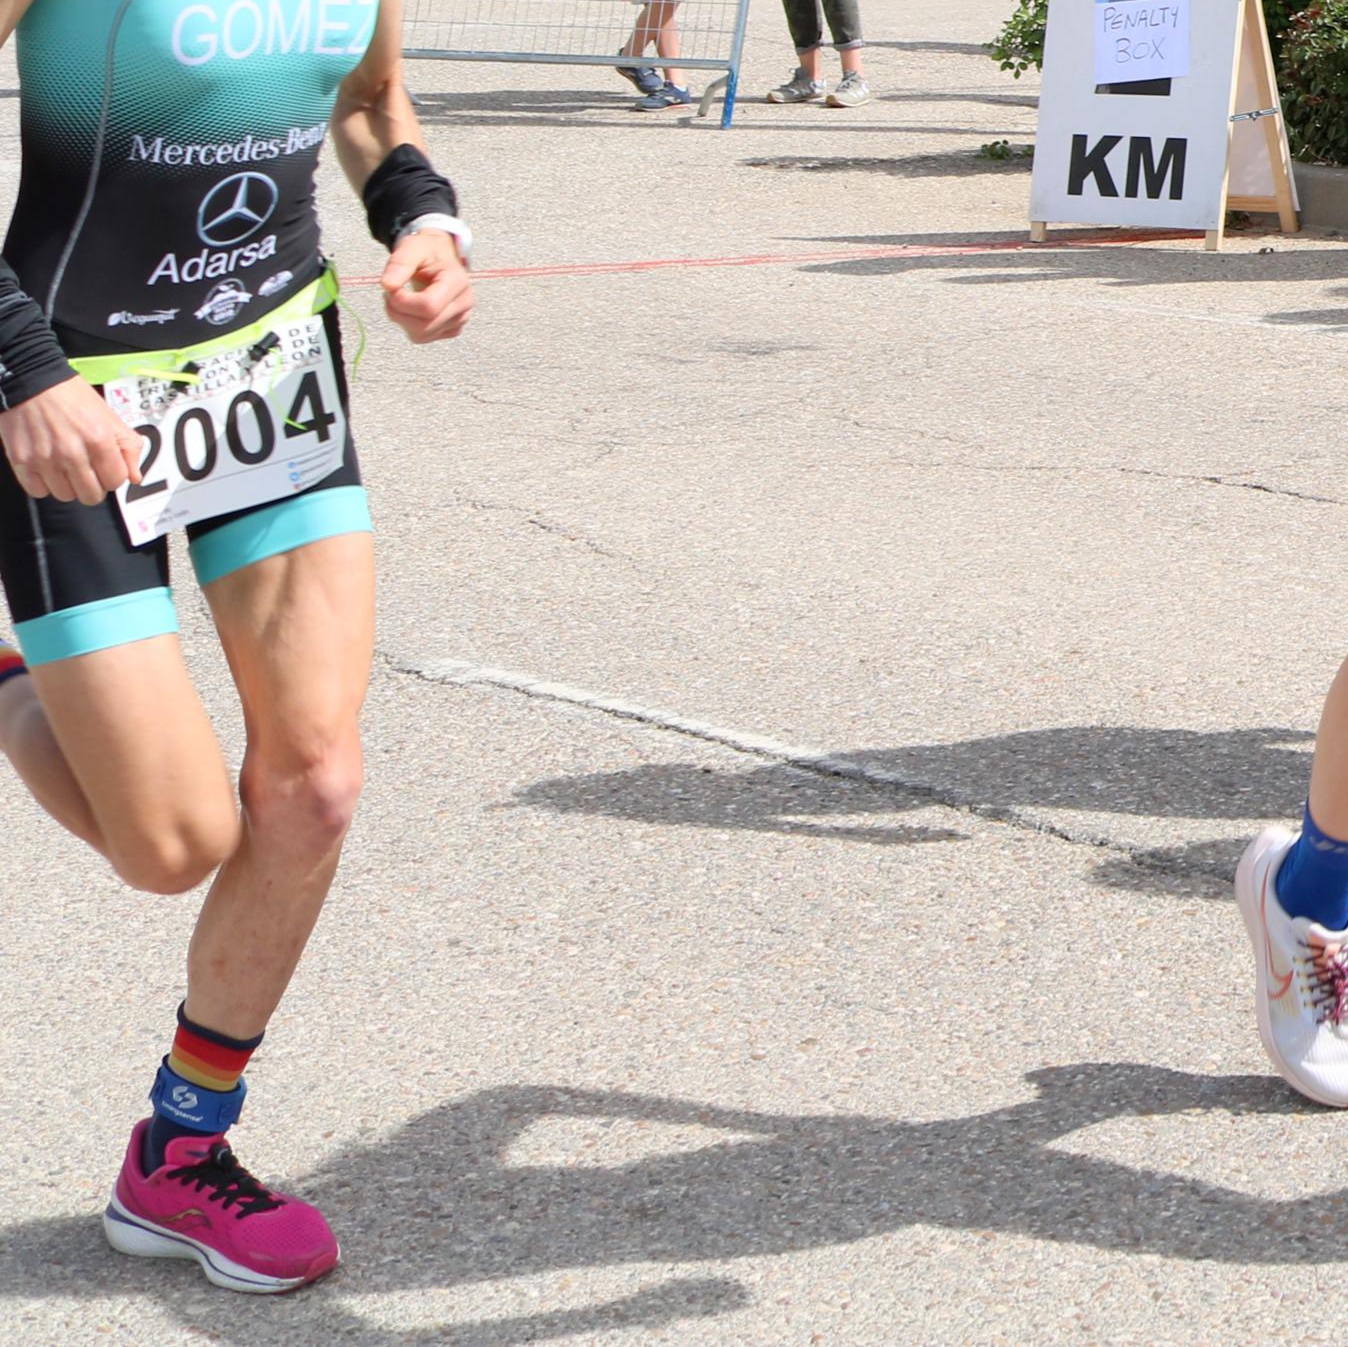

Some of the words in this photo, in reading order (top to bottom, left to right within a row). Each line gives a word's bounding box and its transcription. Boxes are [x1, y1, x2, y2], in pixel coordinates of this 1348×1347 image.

[1103, 6, 1180, 33] PENALTY
[1115, 36, 1165, 64] BOX
[1067, 133, 1188, 201] KM
[146, 234, 278, 286] Adarsa
[288, 322, 318, 338] DE
[292, 335, 322, 349] DE
[125, 370, 336, 504] 2004
